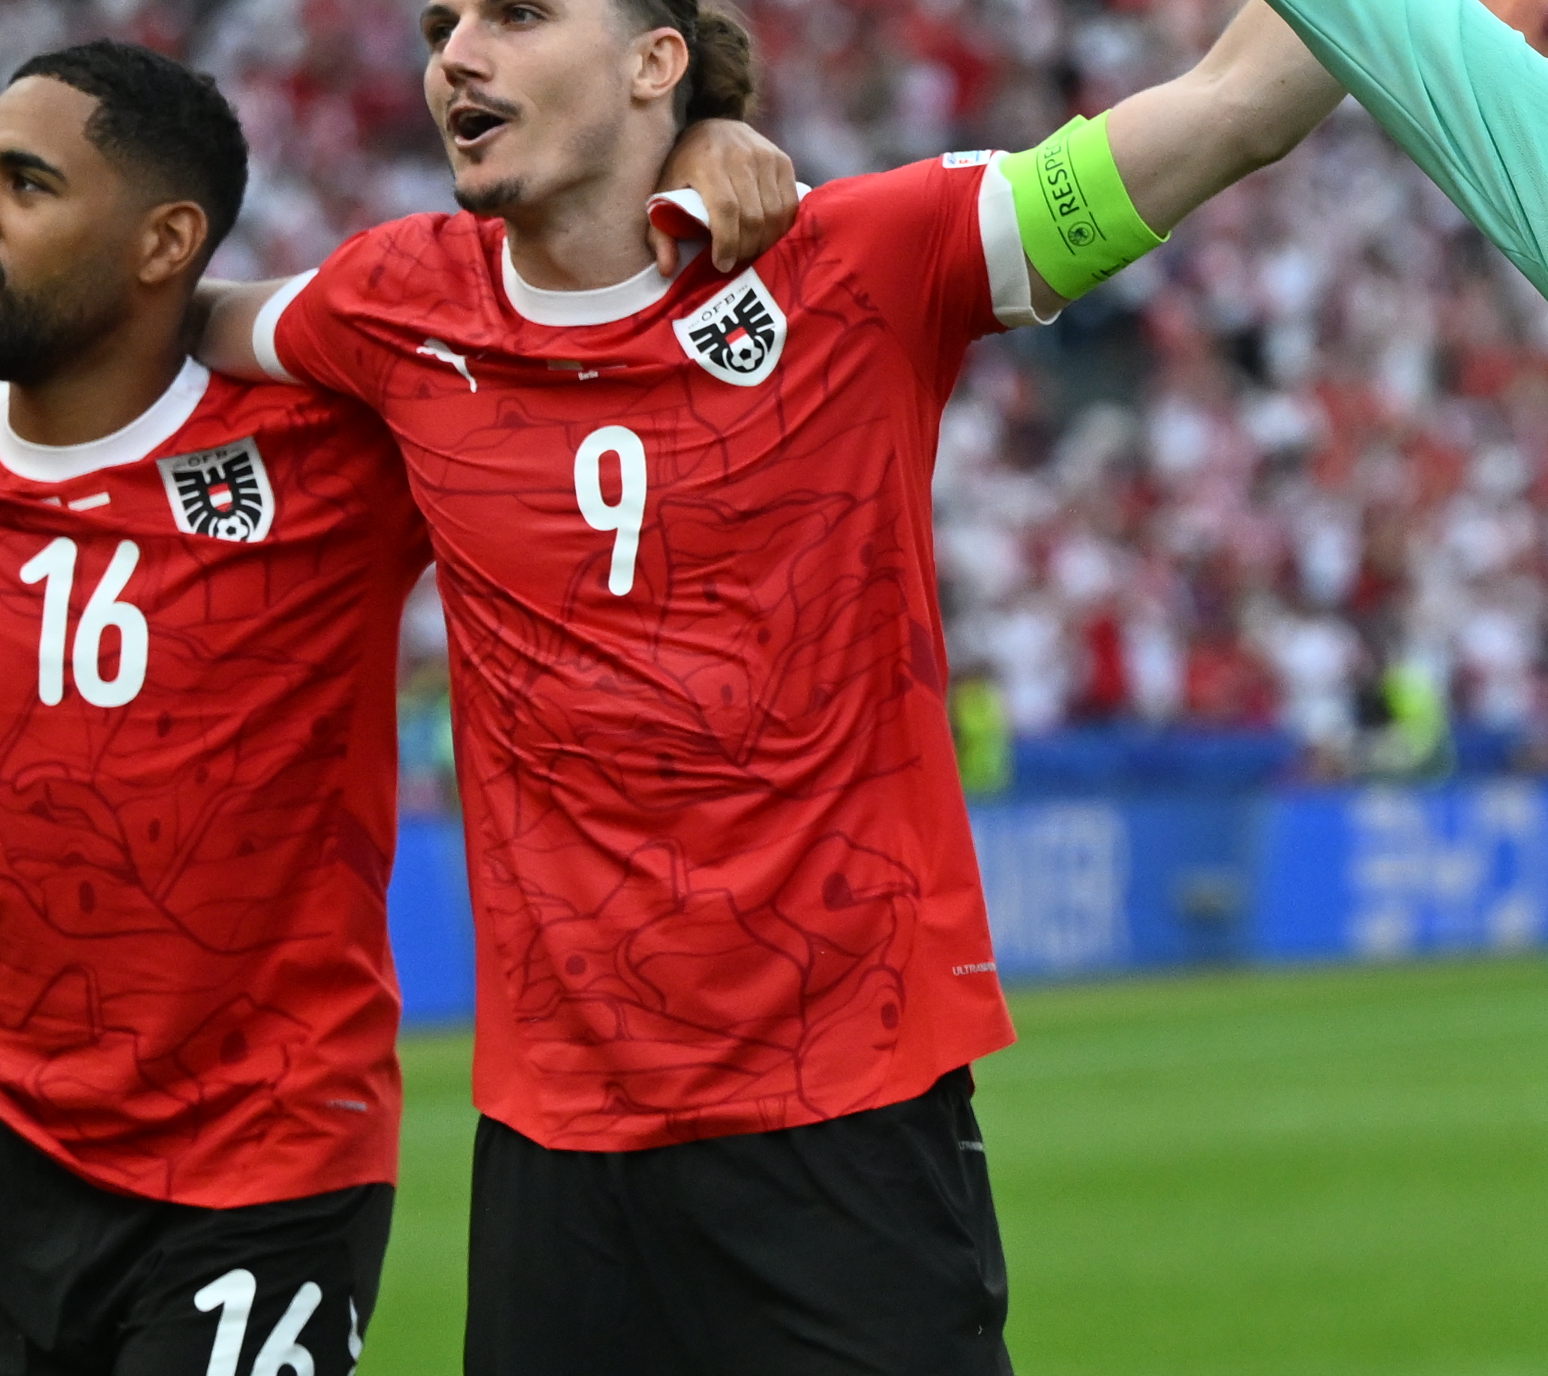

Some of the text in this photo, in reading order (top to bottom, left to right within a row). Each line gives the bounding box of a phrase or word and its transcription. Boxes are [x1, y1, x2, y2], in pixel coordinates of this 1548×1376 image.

[701, 291, 736, 322] ÖFB
[574, 425, 647, 597] 9
[19, 536, 149, 709] 16
